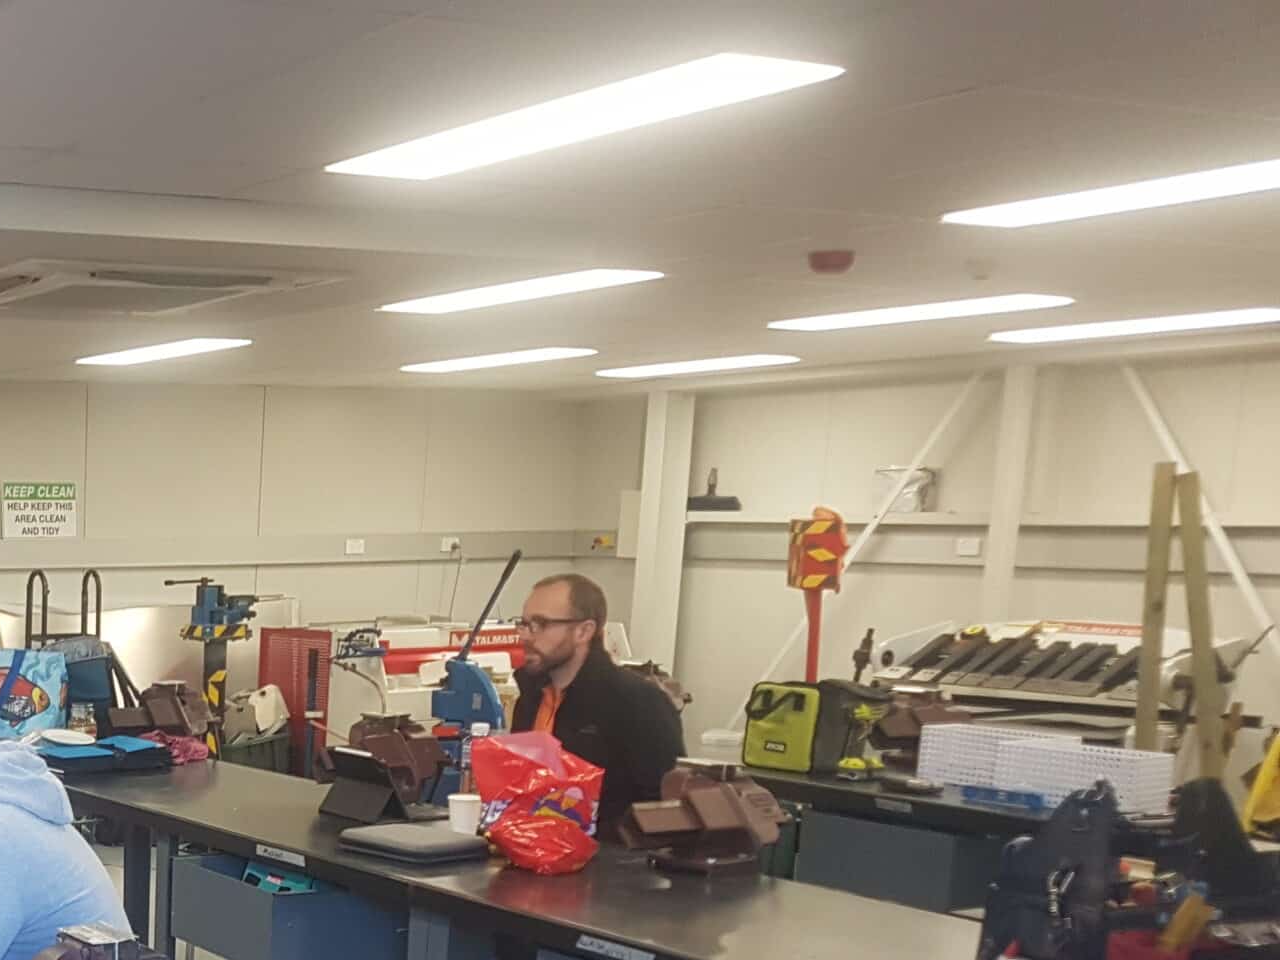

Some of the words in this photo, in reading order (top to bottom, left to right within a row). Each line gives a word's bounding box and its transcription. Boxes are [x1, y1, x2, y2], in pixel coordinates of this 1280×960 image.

[4, 486, 35, 498] KEEP
[37, 485, 75, 498] CLEAN
[7, 502, 29, 511] HELP
[30, 502, 53, 511] KEEP
[54, 502, 73, 511] THIS
[14, 514, 37, 523] AREA
[39, 514, 66, 523] CLEAN
[21, 526, 40, 535] AND
[41, 526, 60, 535] TIDY
[452, 632, 521, 647] MTALMAST
